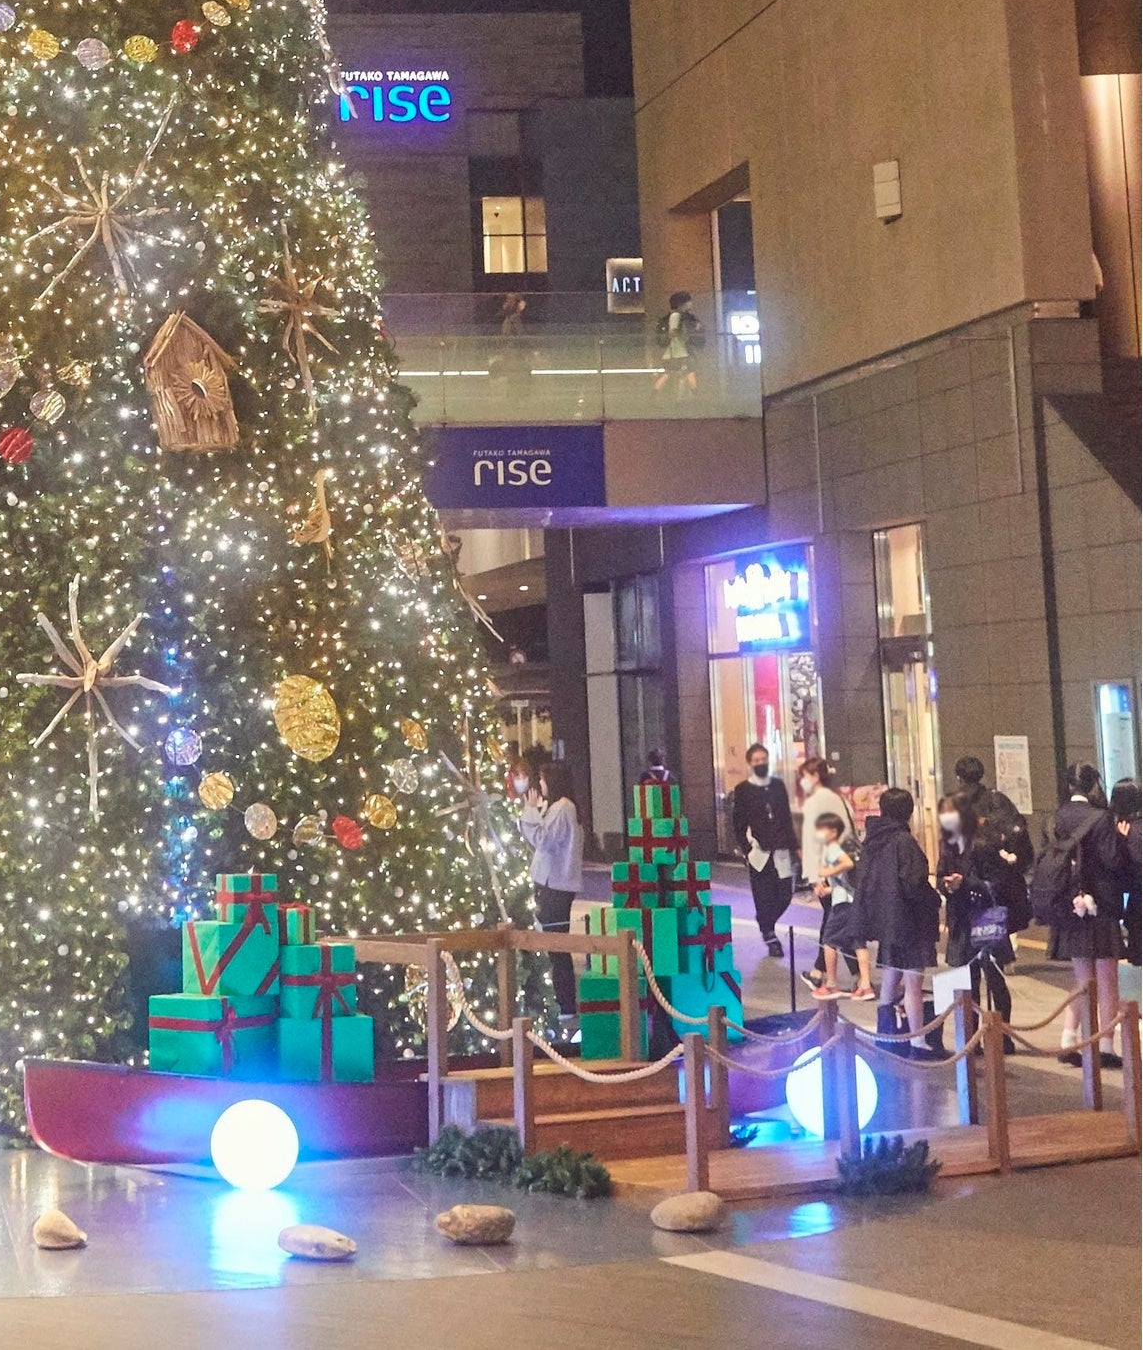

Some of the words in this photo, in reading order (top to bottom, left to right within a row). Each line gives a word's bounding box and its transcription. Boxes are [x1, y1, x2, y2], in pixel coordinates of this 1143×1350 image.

[386, 71, 449, 81] TAMAGAWA
[340, 84, 451, 122] rise
[612, 277, 641, 293] ACT
[473, 449, 505, 457] FUTAKO
[474, 459, 552, 486] rise
